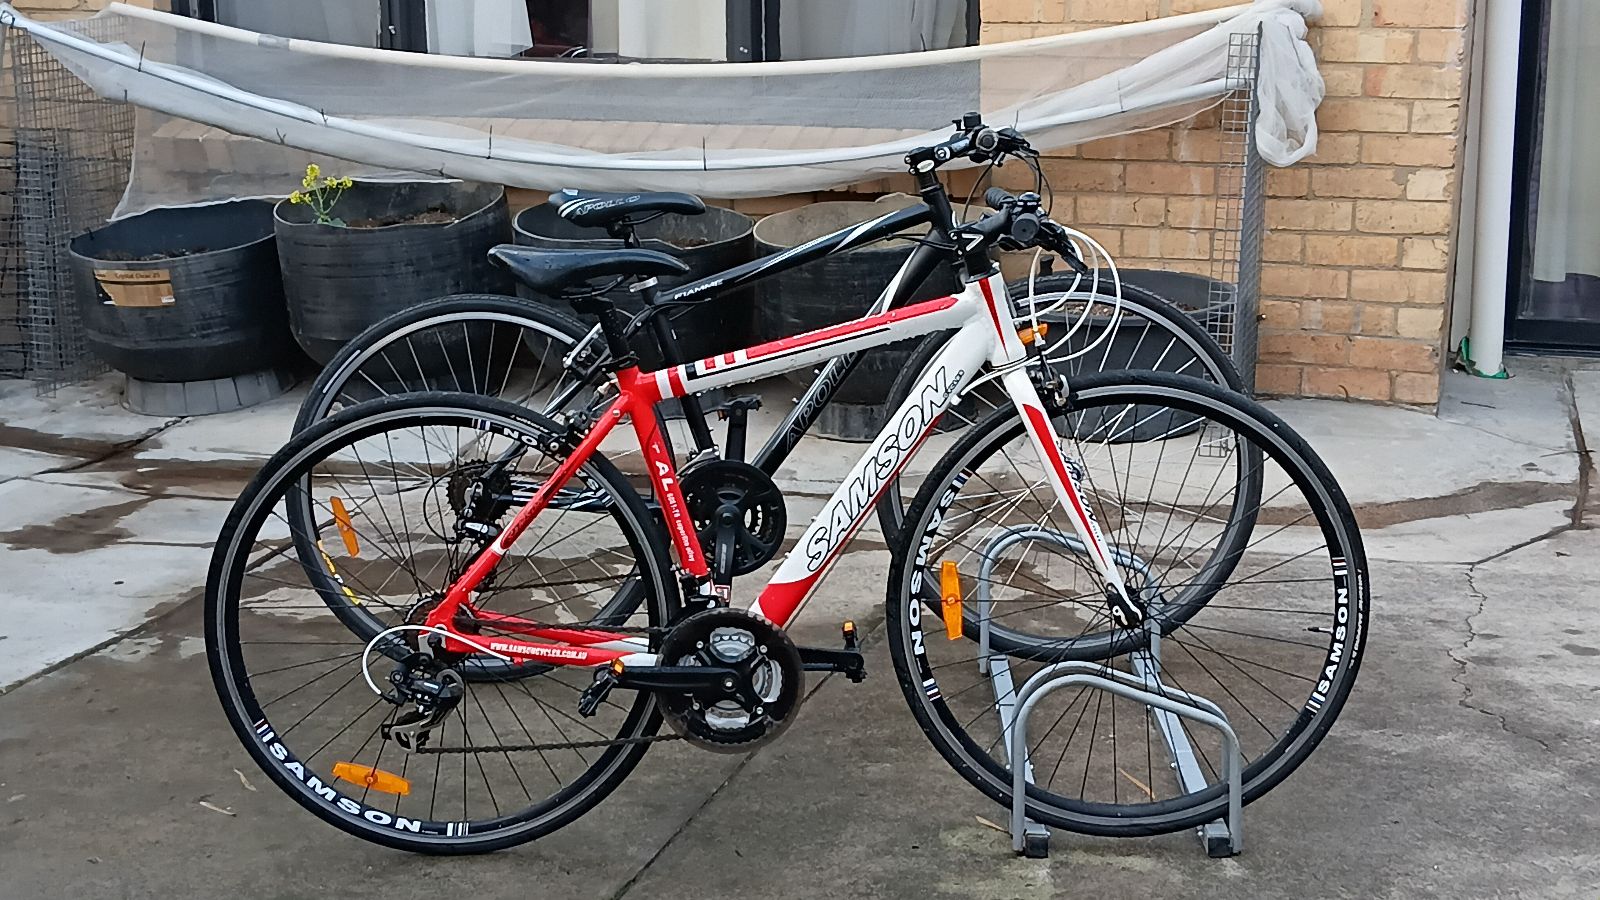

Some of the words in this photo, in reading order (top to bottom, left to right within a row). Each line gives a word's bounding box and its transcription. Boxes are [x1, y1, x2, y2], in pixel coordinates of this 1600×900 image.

[573, 194, 641, 220] APOLLO
[674, 278, 724, 300] FIAMME
[786, 351, 858, 453] APOLL
[655, 460, 674, 492] AL
[807, 365, 948, 572] SAMSON
[910, 488, 956, 656] SAMSON
[1317, 587, 1349, 694] SAMSON
[269, 741, 422, 833] SAMSON
